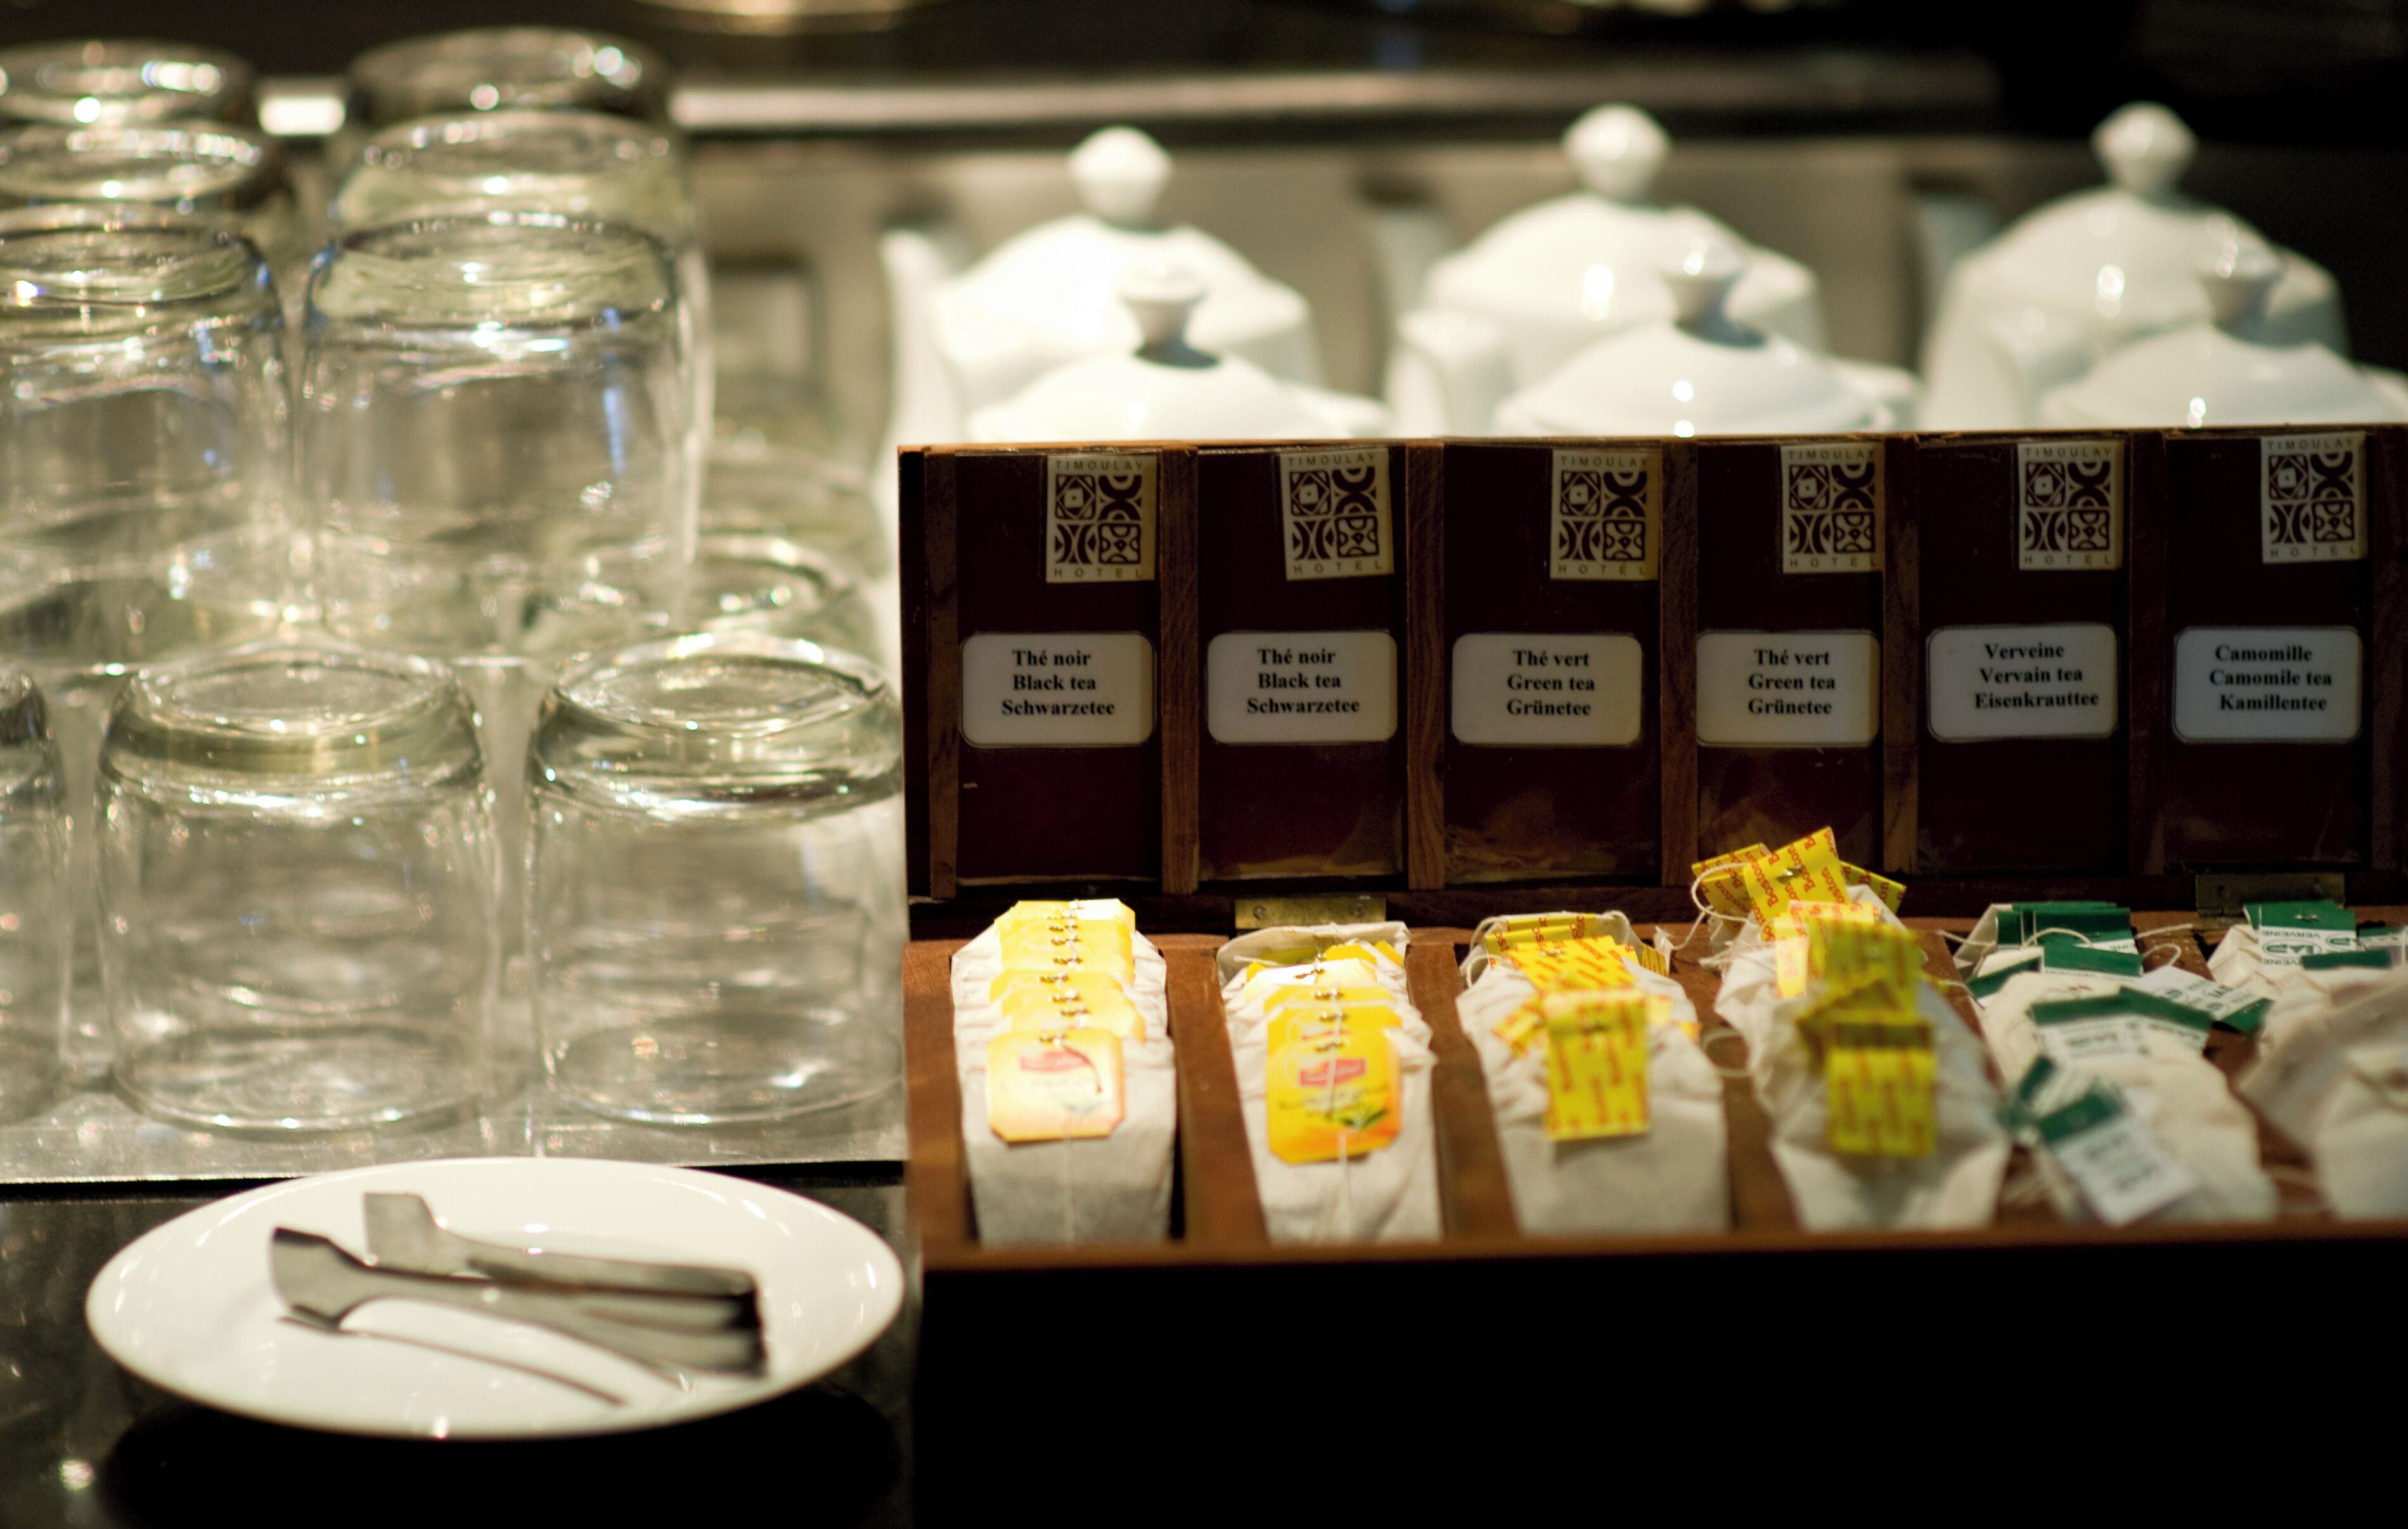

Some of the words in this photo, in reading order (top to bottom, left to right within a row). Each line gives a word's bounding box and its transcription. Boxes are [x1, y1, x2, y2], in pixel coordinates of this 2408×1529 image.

[2025, 446, 2112, 457] TIMOULAY
[2267, 439, 2353, 450] TIMOULAY
[1287, 453, 1377, 466] TIMOULAY
[1560, 456, 1649, 467] TIMOULAY
[1788, 449, 1876, 460] TIMOULAY
[1055, 460, 1144, 471] TIMOULAY
[2270, 546, 2359, 557] HOTEL
[1294, 560, 1382, 574] HOTEL
[1790, 557, 1879, 568] HOTEL
[2024, 555, 2113, 565] HOTEL
[1053, 567, 1143, 578] HOTEL
[1557, 564, 1647, 576] HOTEL
[1013, 650, 1048, 666] Thé
[1054, 650, 1091, 666] noir
[1258, 648, 1292, 664] Thé
[1299, 648, 1336, 664] noir
[1514, 650, 1548, 666] Thé
[1554, 654, 1588, 666] vert
[1755, 649, 1789, 665] Thé
[1794, 652, 1829, 665] vert
[1985, 643, 2064, 659] Verveine
[2215, 645, 2312, 661] Camomille
[1014, 674, 1064, 690] Black
[1071, 677, 1096, 690] tea
[1258, 673, 1309, 688] Black
[1315, 675, 1341, 688] tea
[1748, 674, 1803, 689] Green
[1810, 676, 1835, 689] tea
[1980, 667, 2051, 683] Vervain
[2057, 668, 2082, 681] tea
[2210, 670, 2300, 685] Camomile
[2307, 673, 2332, 685] tea
[1507, 675, 1562, 690] Green
[1569, 677, 1595, 691] tea
[1002, 700, 1114, 715] Schwarzetee
[1247, 698, 1360, 714] Schwarzetee
[1507, 700, 1591, 716] Grünetee
[1748, 699, 1832, 714] Grünetee
[1975, 692, 2099, 709] Eisenkrauttee
[2220, 694, 2326, 710] Kamillentee
